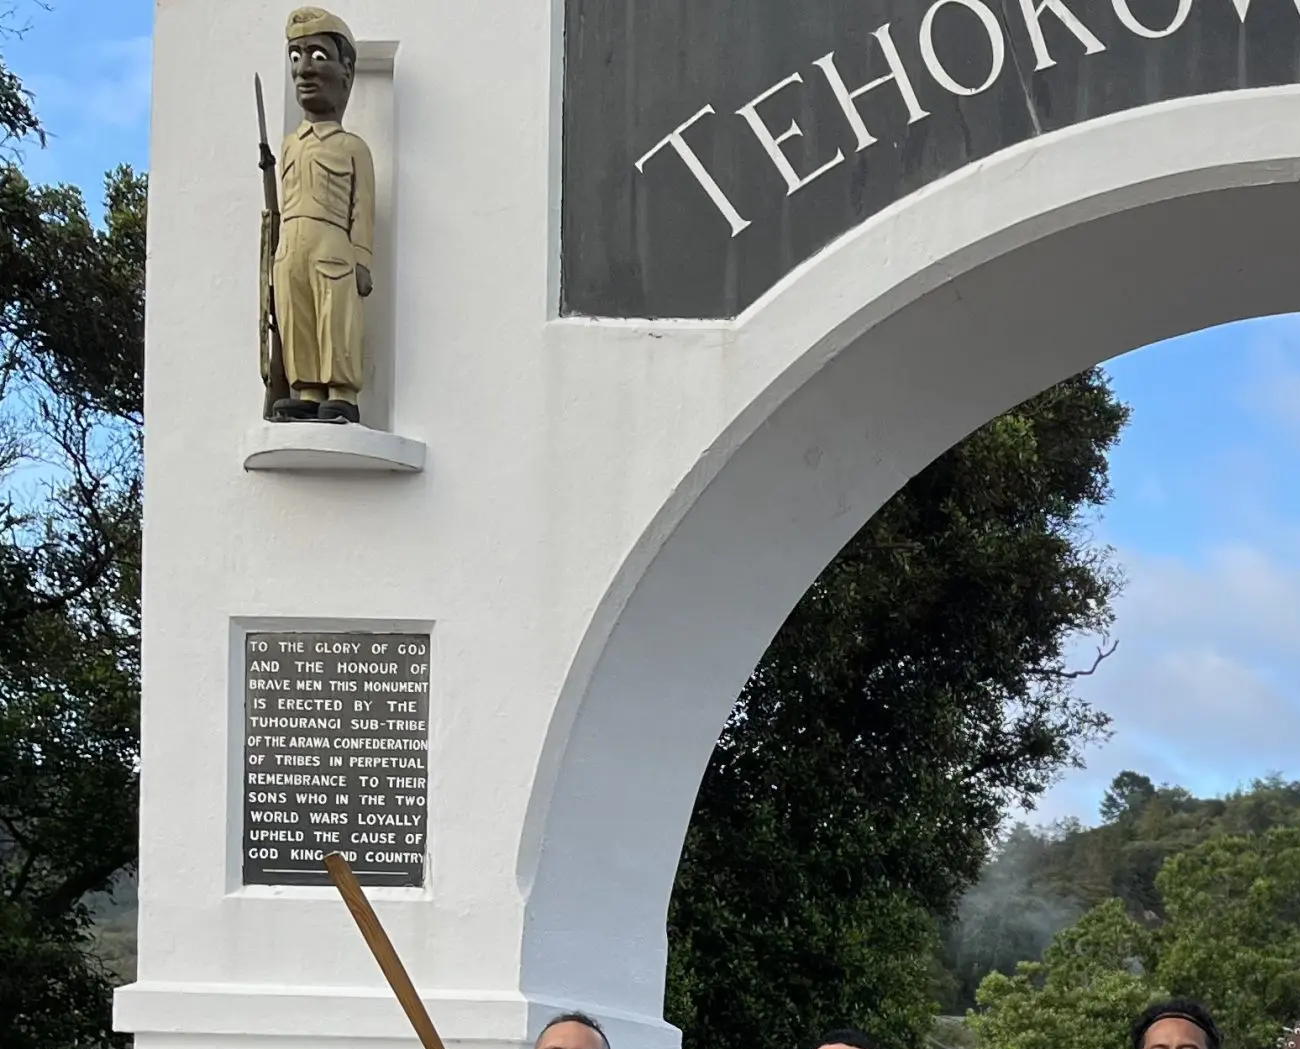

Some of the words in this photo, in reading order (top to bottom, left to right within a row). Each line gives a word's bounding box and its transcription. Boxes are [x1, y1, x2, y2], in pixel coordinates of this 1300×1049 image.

[249, 641, 268, 652] TO
[278, 642, 304, 652] THE
[315, 642, 361, 654] GLORY
[371, 643, 388, 654] OF
[398, 644, 425, 655] GOD
[250, 660, 279, 672] AND
[294, 661, 324, 673] THE
[337, 662, 398, 674] HONOUR
[410, 664, 428, 675] OF
[249, 679, 290, 690] BRAVE
[296, 680, 322, 691] MEN
[329, 681, 357, 692] THIS
[364, 681, 428, 693] MONUMENT
[254, 698, 266, 709] IS
[278, 698, 342, 711] ERECTED
[354, 700, 372, 711] BY
[387, 701, 417, 712] THE
[249, 716, 341, 729] TUHOURANGI
[351, 719, 426, 731] SUB-TRIBE
[248, 736, 262, 747] OF
[264, 736, 286, 747] THE
[289, 737, 330, 748] ARAWA
[333, 737, 428, 751] CONFEDERATION
[249, 755, 265, 765] OF
[275, 755, 320, 766] TRIBES
[330, 756, 342, 766] IN
[349, 757, 425, 769] PERPETUAL
[248, 773, 346, 786] REMEMBRANCE
[359, 776, 379, 788] TO
[386, 777, 426, 788] THEIR
[249, 792, 287, 803] SONS
[296, 793, 327, 804] WHO
[336, 794, 348, 804] IN
[359, 795, 385, 805] THE
[395, 795, 425, 806] TWO
[251, 811, 299, 823] WORLD
[310, 812, 348, 824] WARS
[358, 813, 421, 826] LOYALLY
[250, 830, 304, 841] UPHELD
[314, 831, 339, 842] THE
[351, 833, 396, 844] CAUSE
[405, 834, 423, 844] OF
[249, 848, 278, 859] GOD
[291, 849, 323, 860] KING
[340, 851, 357, 862] ND
